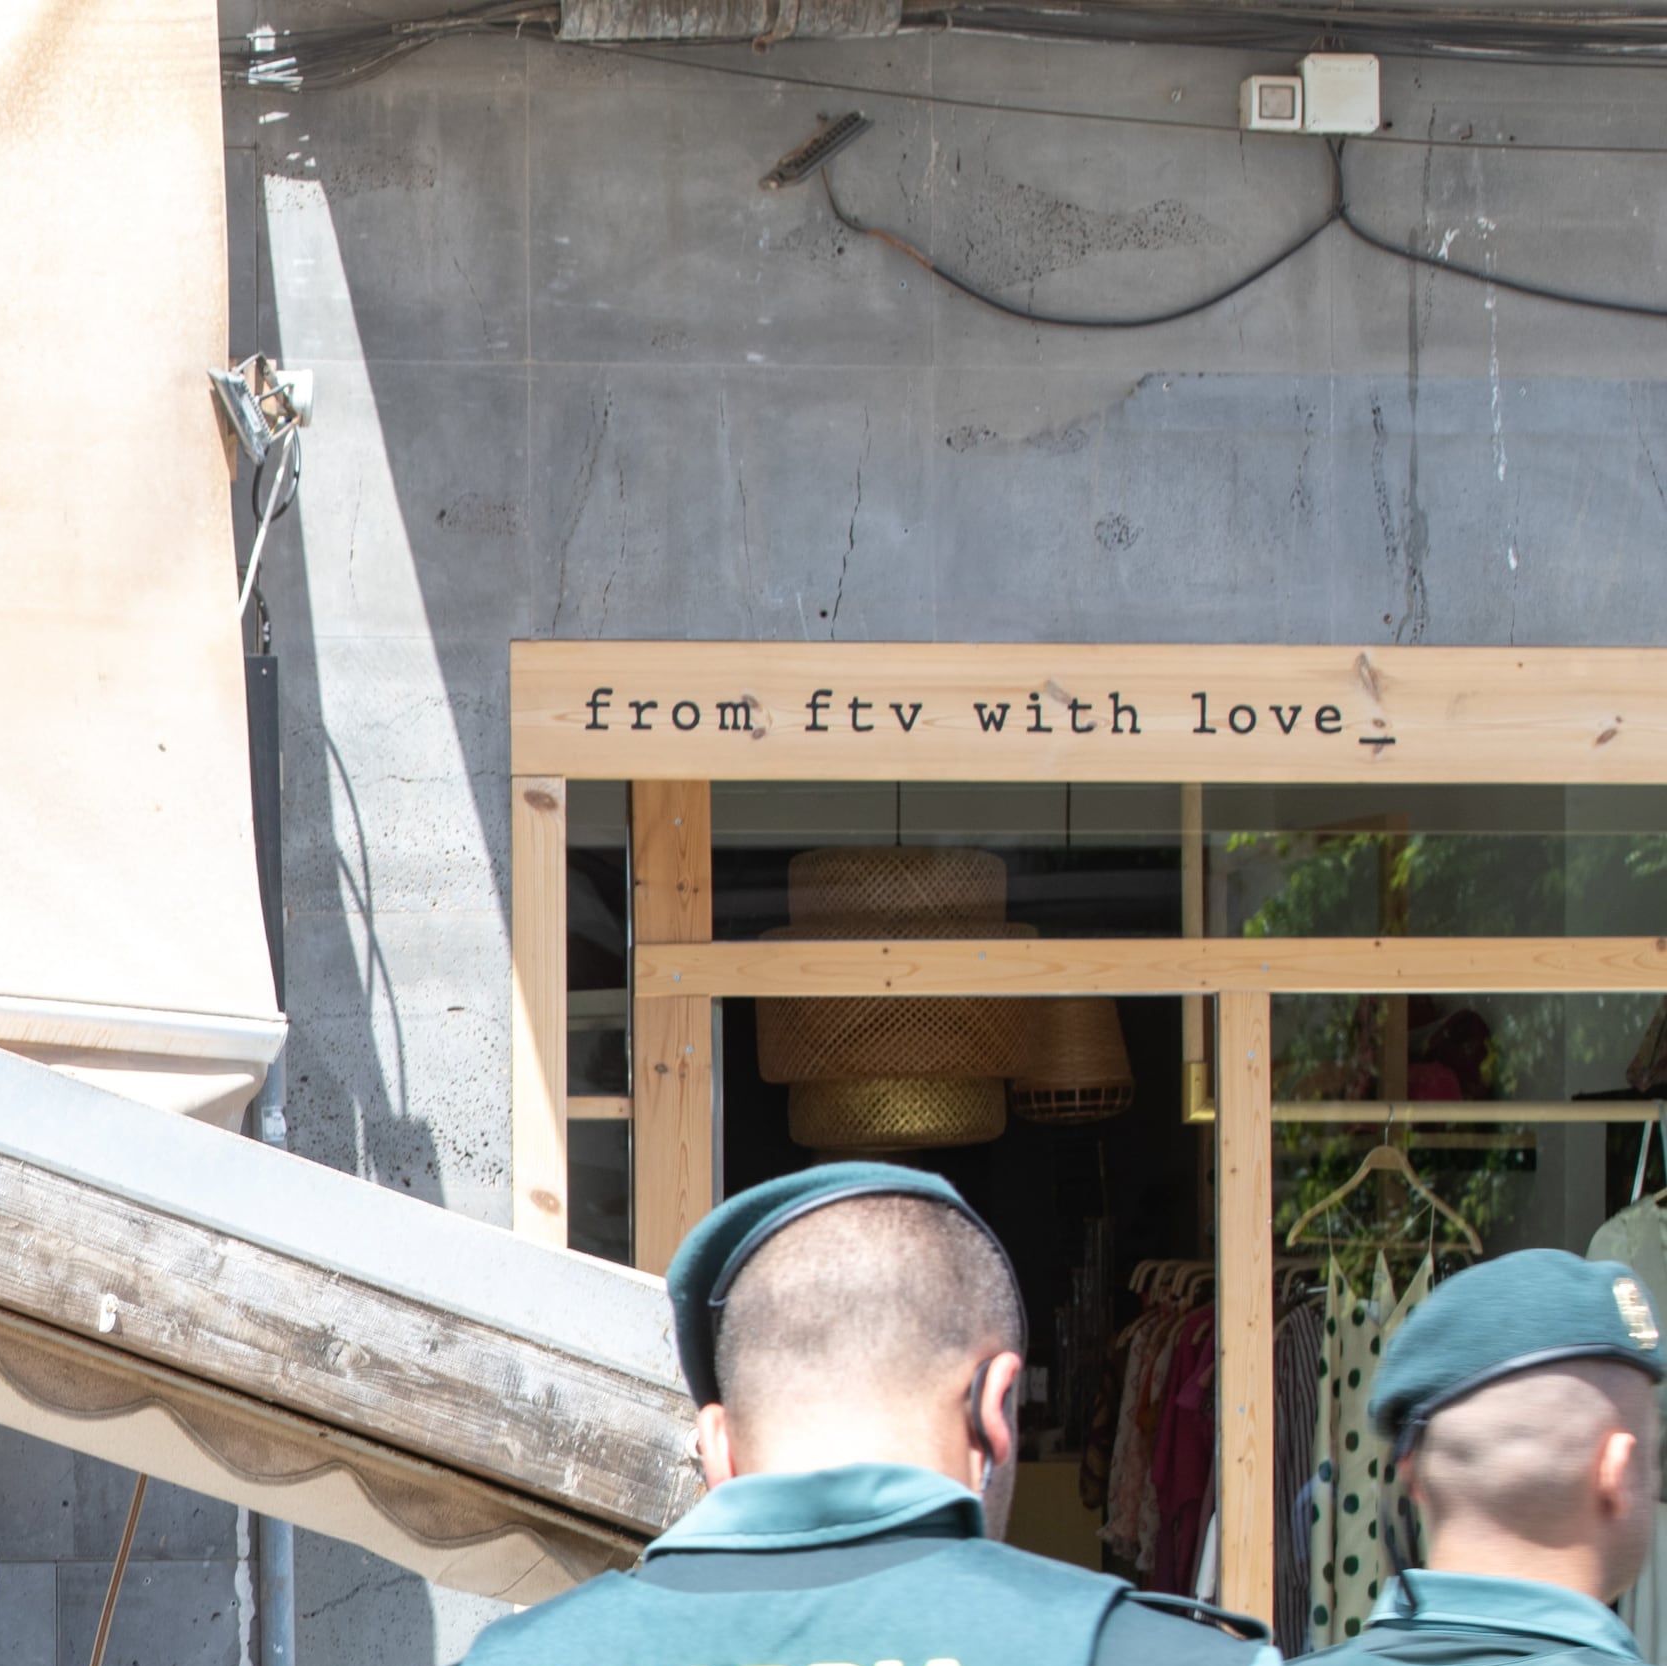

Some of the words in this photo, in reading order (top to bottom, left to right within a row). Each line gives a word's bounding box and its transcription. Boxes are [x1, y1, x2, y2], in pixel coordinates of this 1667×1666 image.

[584, 688, 754, 735] from
[803, 688, 924, 735] ftv
[972, 690, 1142, 736] with
